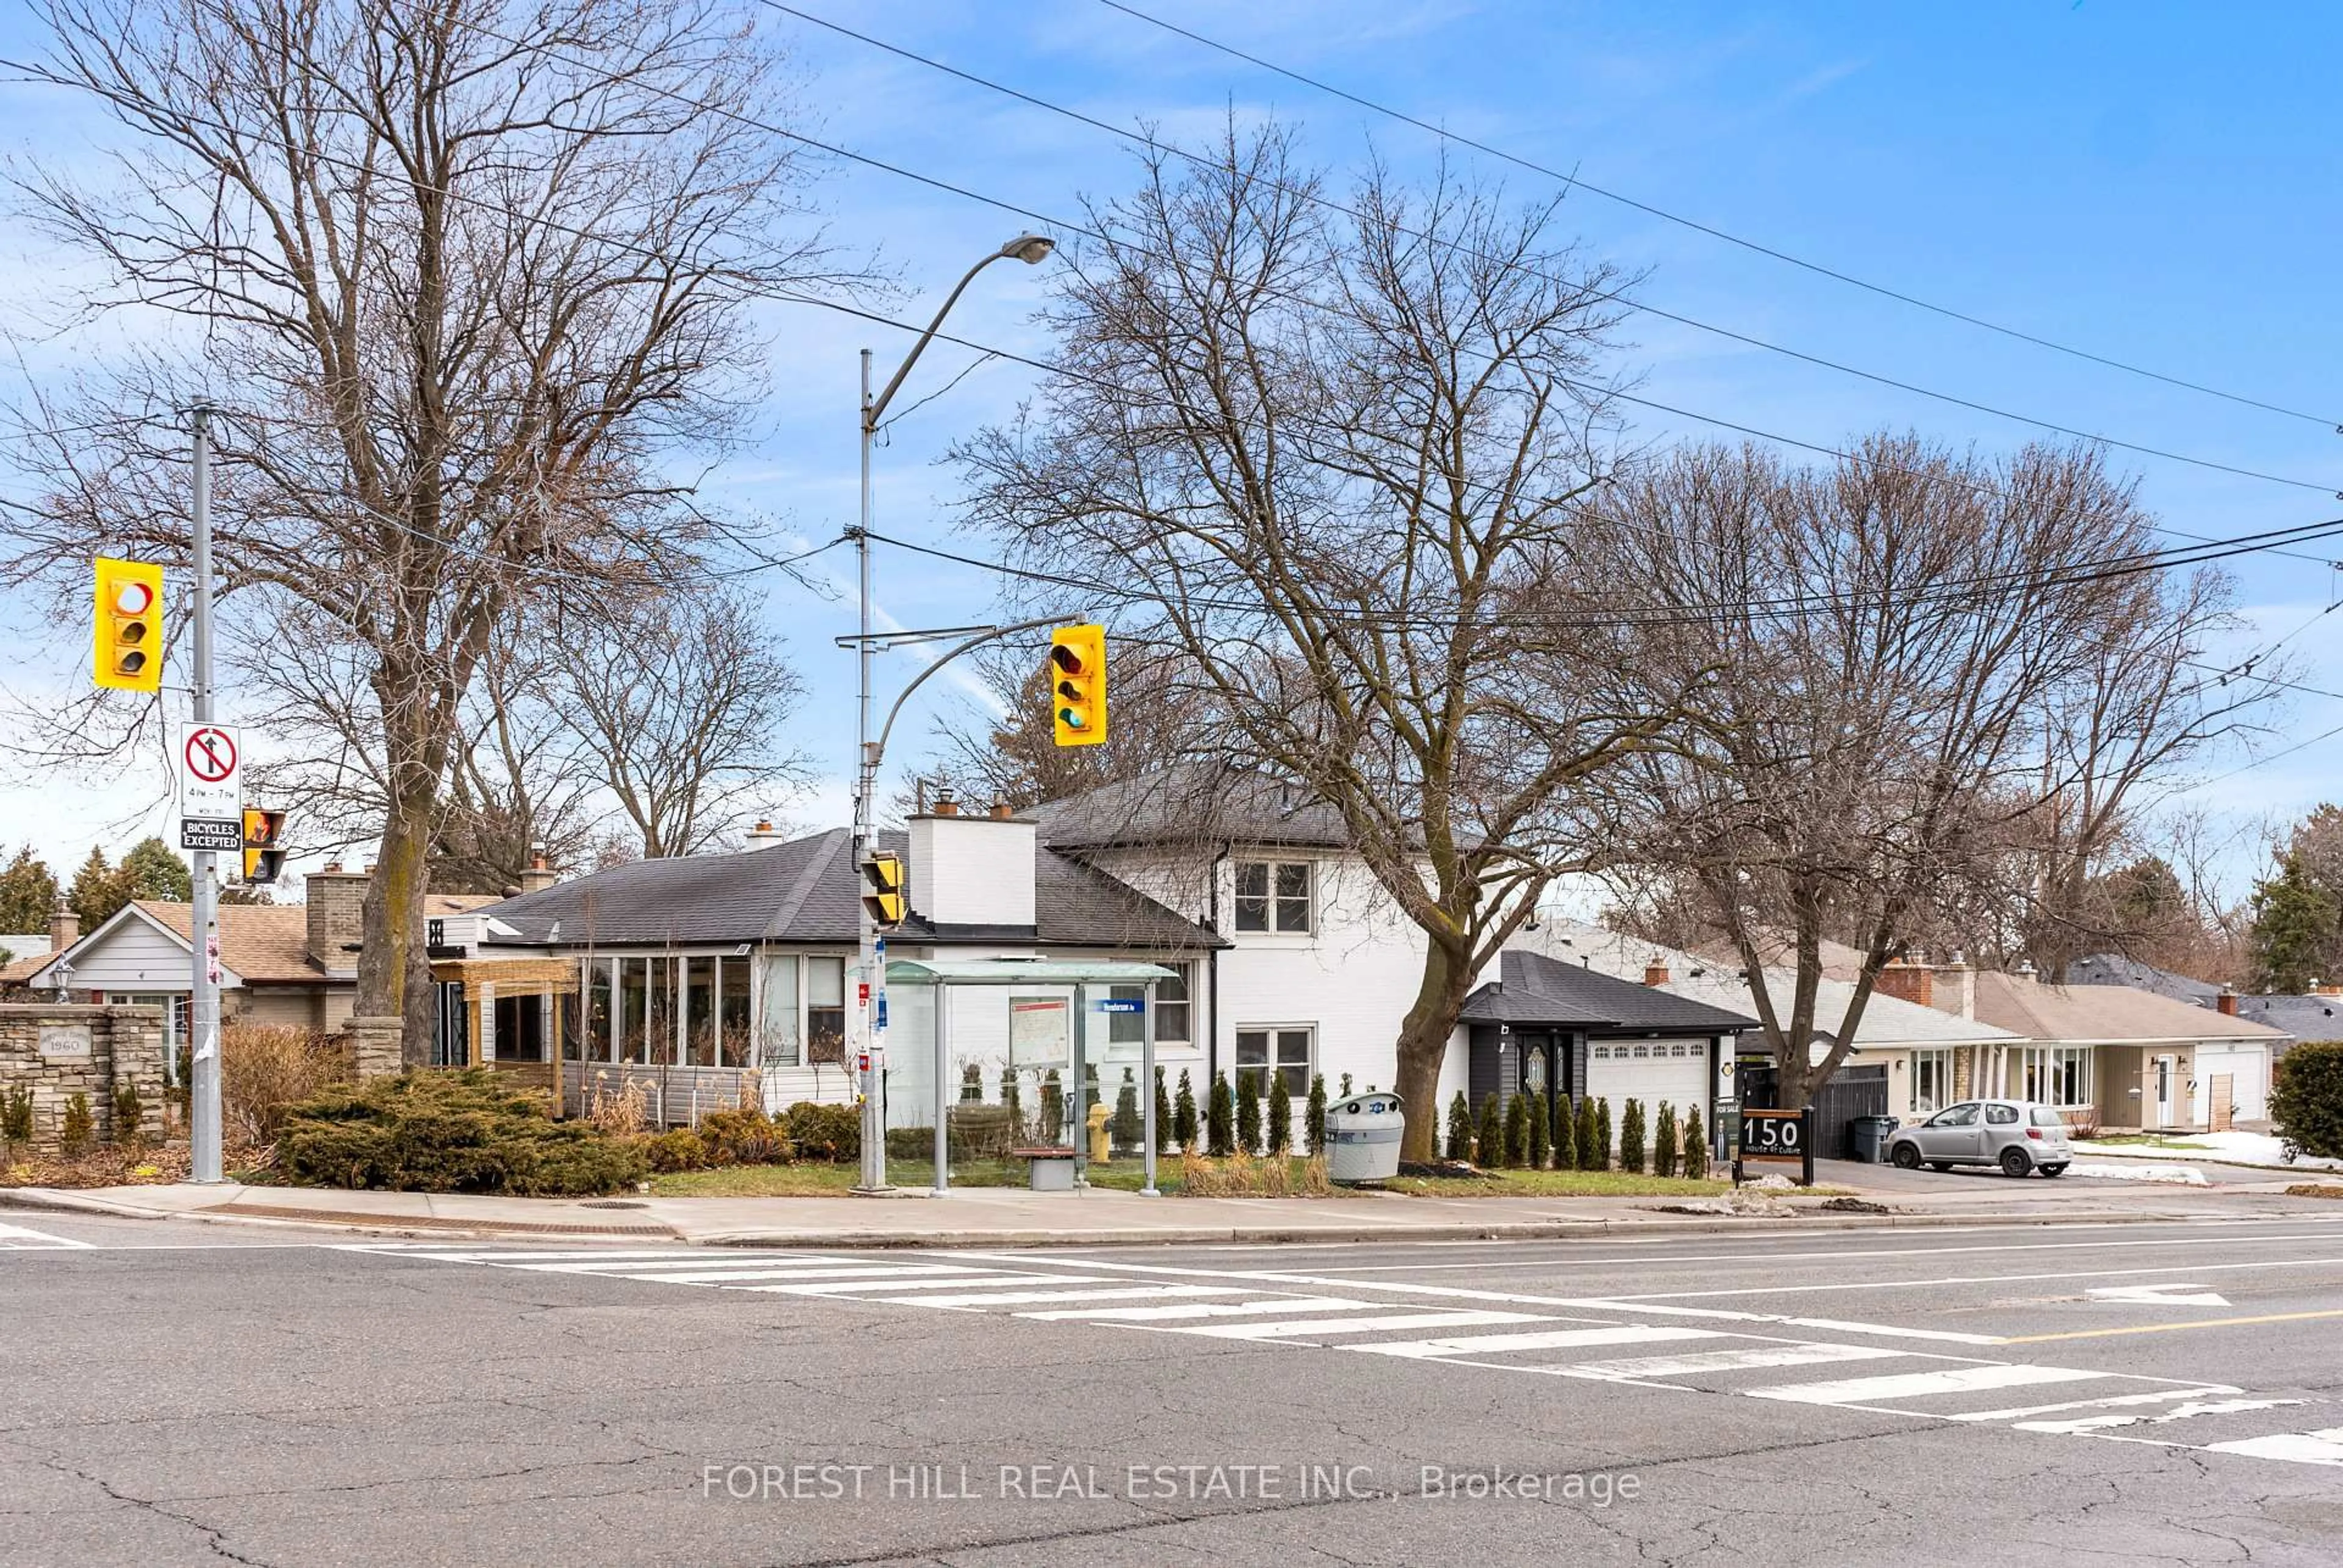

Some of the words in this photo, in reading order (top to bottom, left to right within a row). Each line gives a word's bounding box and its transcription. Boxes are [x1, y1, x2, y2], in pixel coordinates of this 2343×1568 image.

[187, 822, 235, 835] BICYCLES
[184, 835, 237, 847] EXCEPTED
[51, 1041, 79, 1051] 1960
[1744, 1118, 1798, 1146] 150
